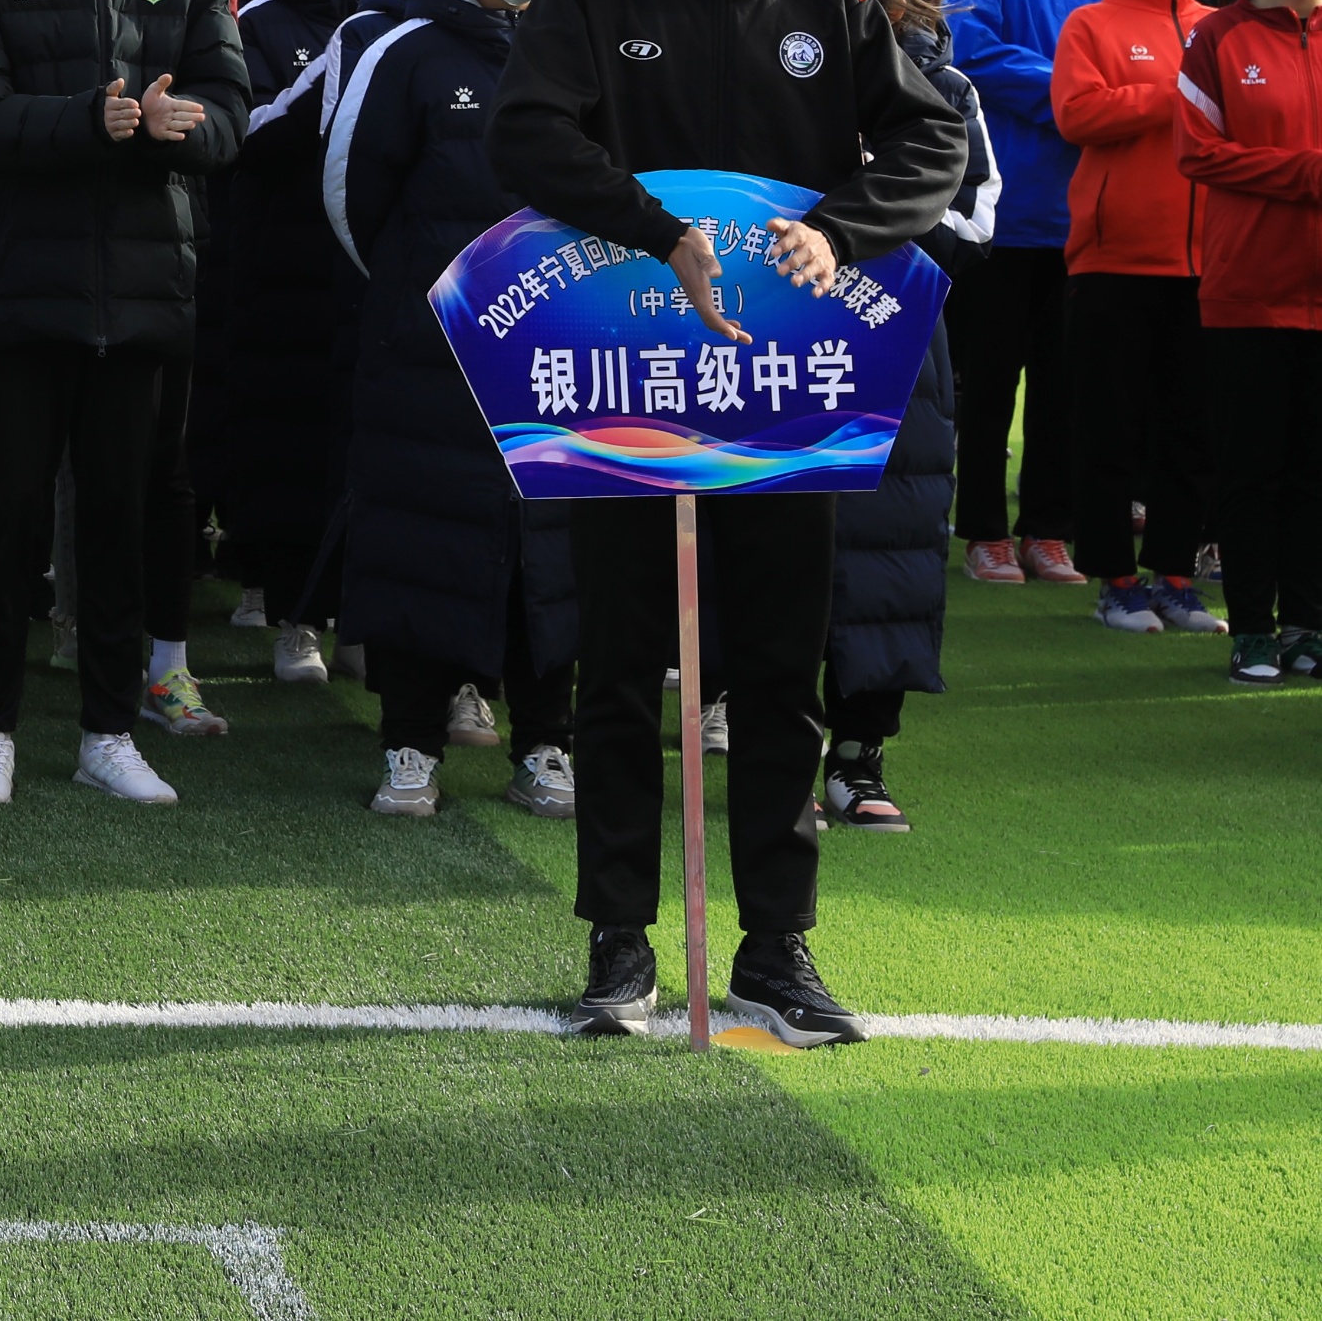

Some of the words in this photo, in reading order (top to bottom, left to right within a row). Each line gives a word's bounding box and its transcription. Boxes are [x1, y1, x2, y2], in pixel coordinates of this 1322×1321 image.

[1240, 77, 1267, 85] KELME
[450, 102, 481, 110] KELME
[529, 337, 857, 417] 银川高级中学
